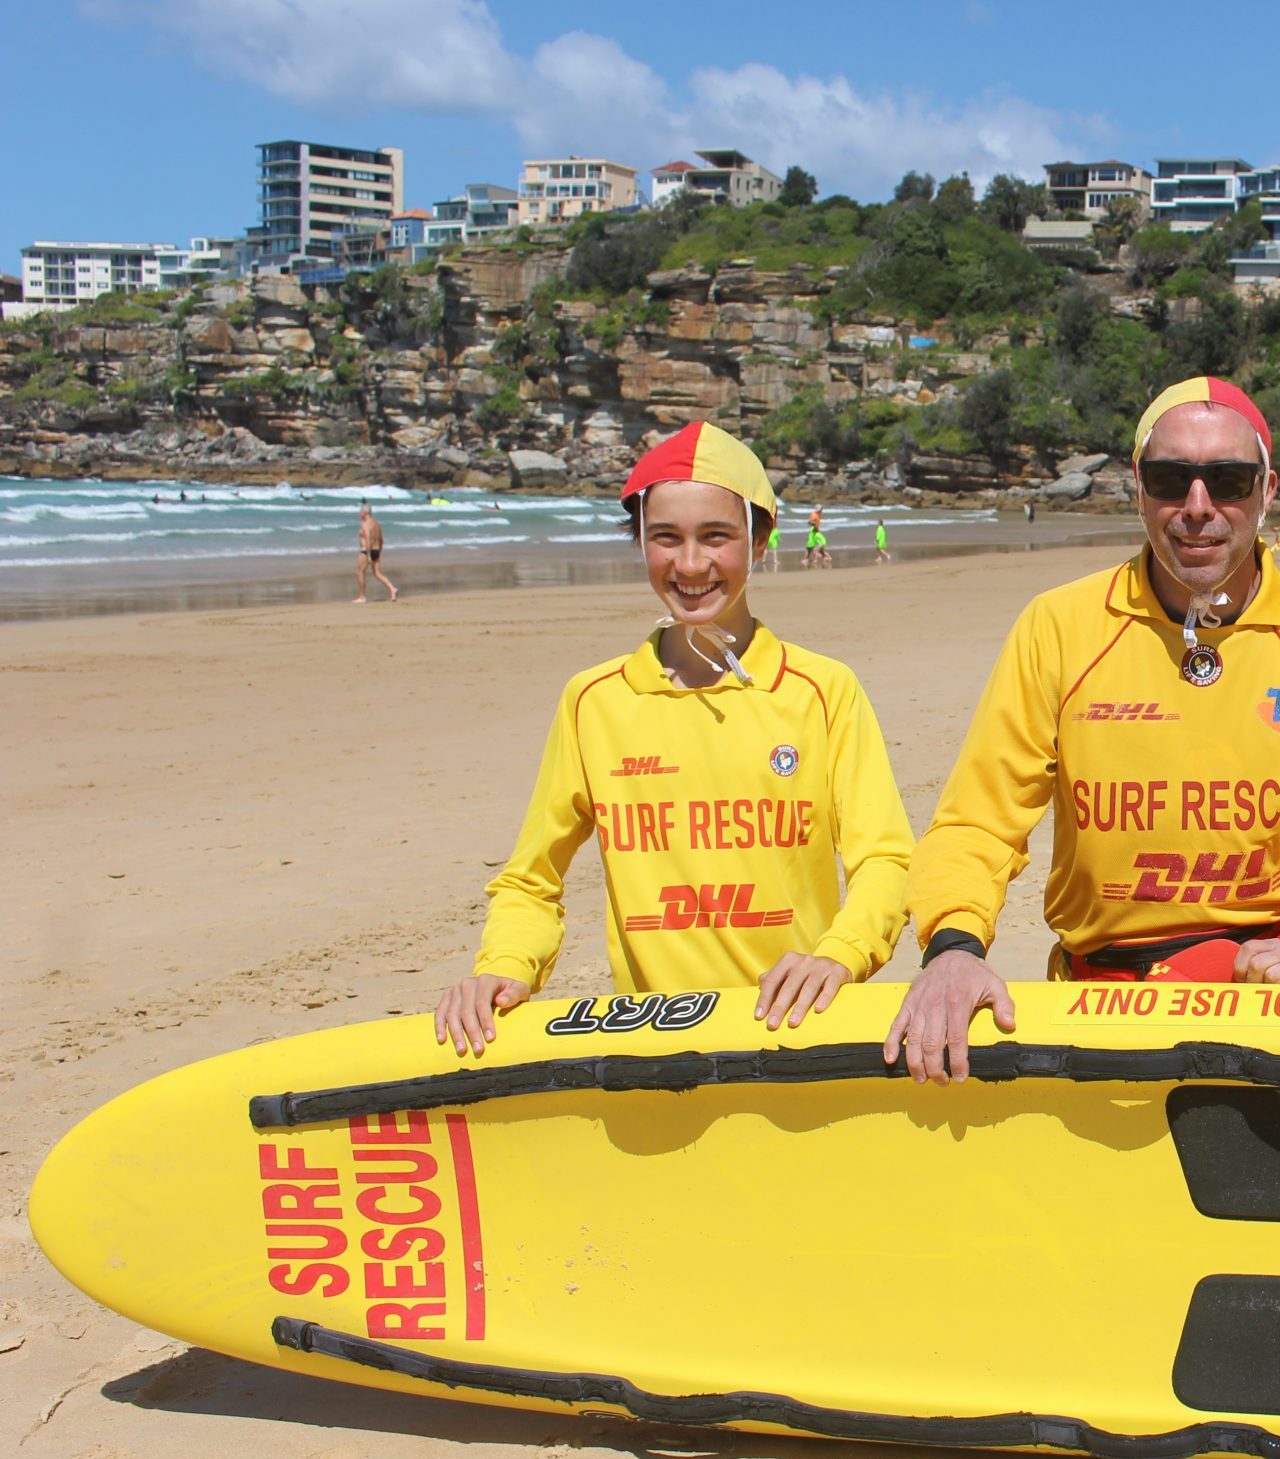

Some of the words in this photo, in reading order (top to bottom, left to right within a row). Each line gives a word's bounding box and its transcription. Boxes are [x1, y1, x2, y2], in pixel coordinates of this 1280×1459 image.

[1191, 645, 1216, 654] SURF
[1197, 666, 1222, 686] SAVING
[1086, 703, 1166, 720] DHL
[620, 755, 665, 776] DHL
[594, 801, 675, 852] SURF
[688, 798, 813, 850] RESCUE
[1073, 779, 1168, 831] SURF
[1131, 847, 1272, 903] DHL
[657, 883, 766, 930] DHL
[545, 991, 721, 1036] BRT
[1066, 987, 1159, 1016] ONLY
[1168, 988, 1240, 1017] USE
[258, 1143, 350, 1298] SURF
[348, 1110, 446, 1341] RESCUE
